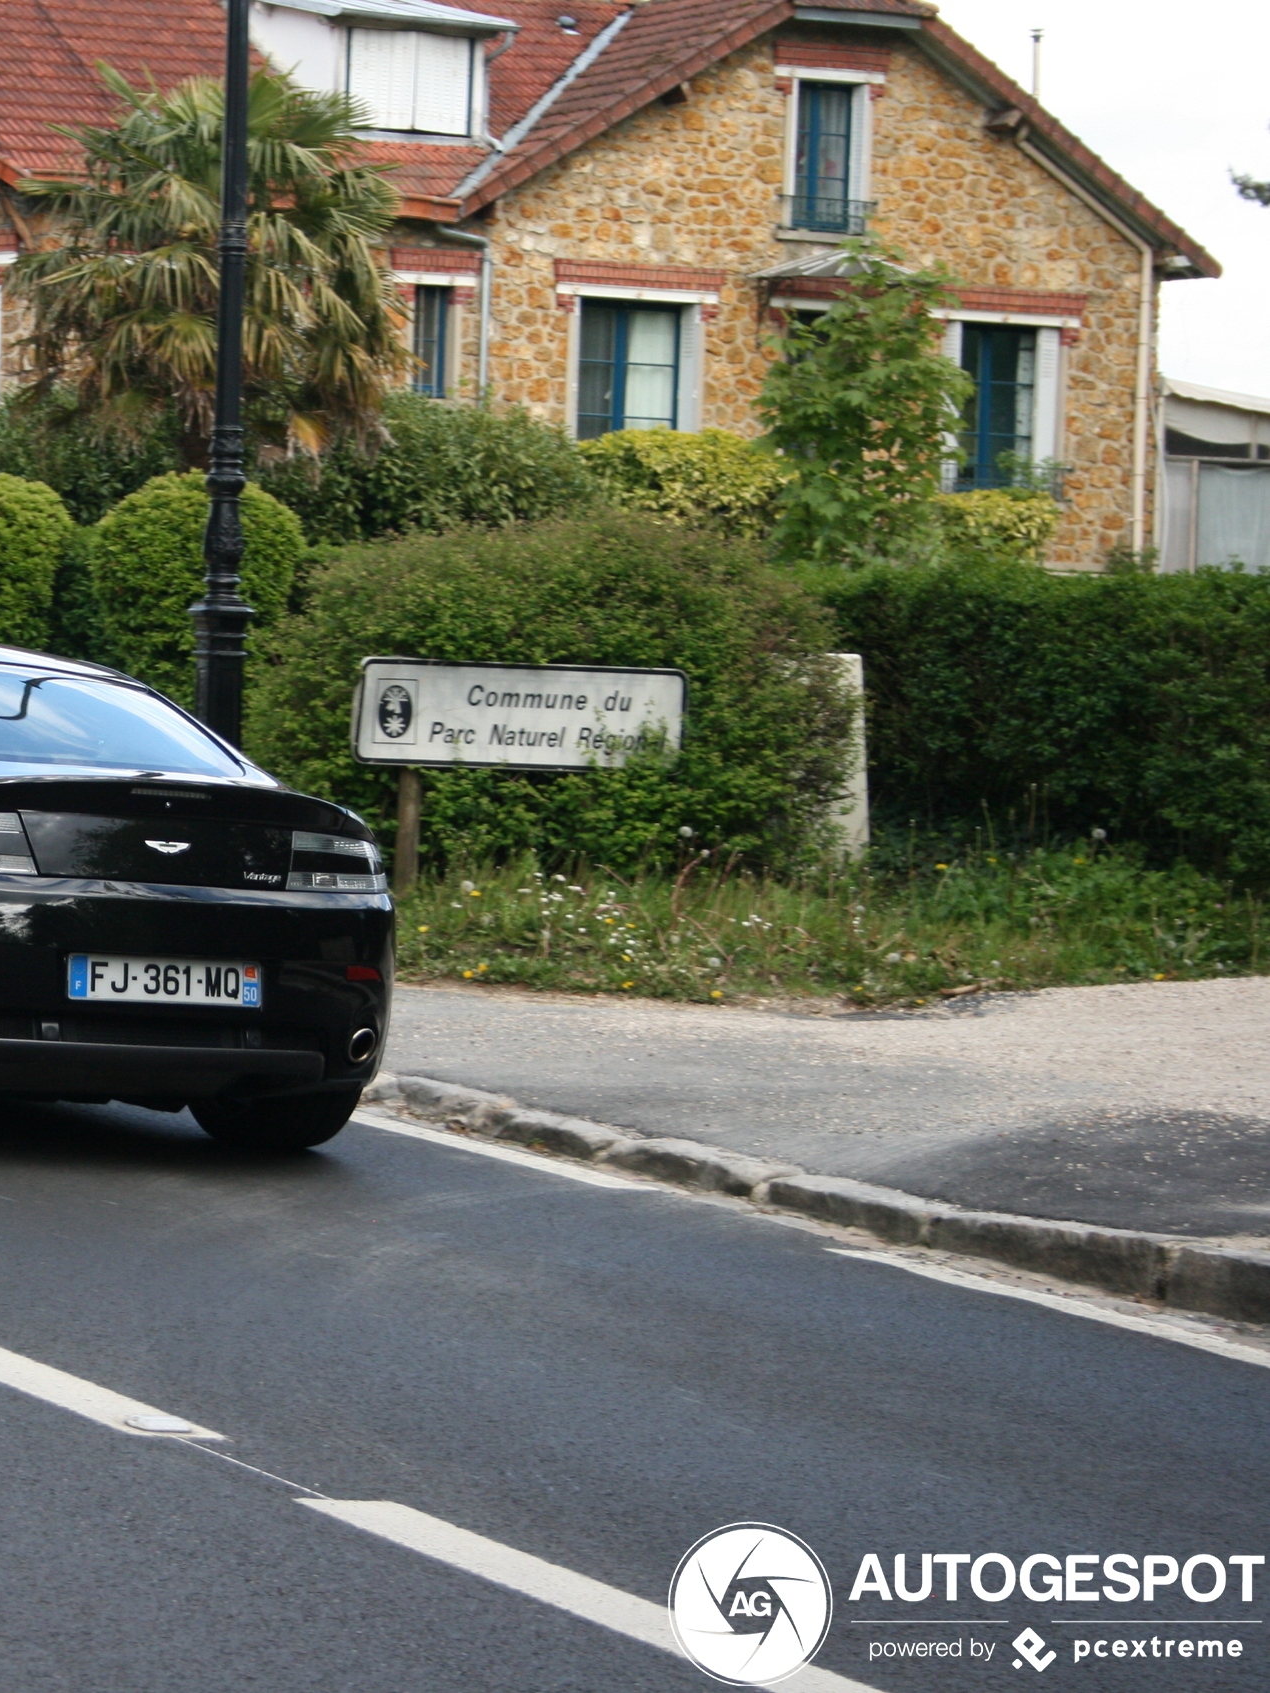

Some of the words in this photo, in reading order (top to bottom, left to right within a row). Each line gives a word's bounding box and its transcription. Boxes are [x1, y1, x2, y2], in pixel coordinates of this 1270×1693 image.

[467, 685, 587, 711] Commune
[604, 690, 632, 712] du
[428, 722, 476, 744] Parc
[488, 724, 566, 748] Naturel
[576, 725, 667, 756] Régionl
[75, 980, 82, 990] F
[91, 961, 240, 1000] FJ-361-MQ
[244, 986, 257, 1002] 50
